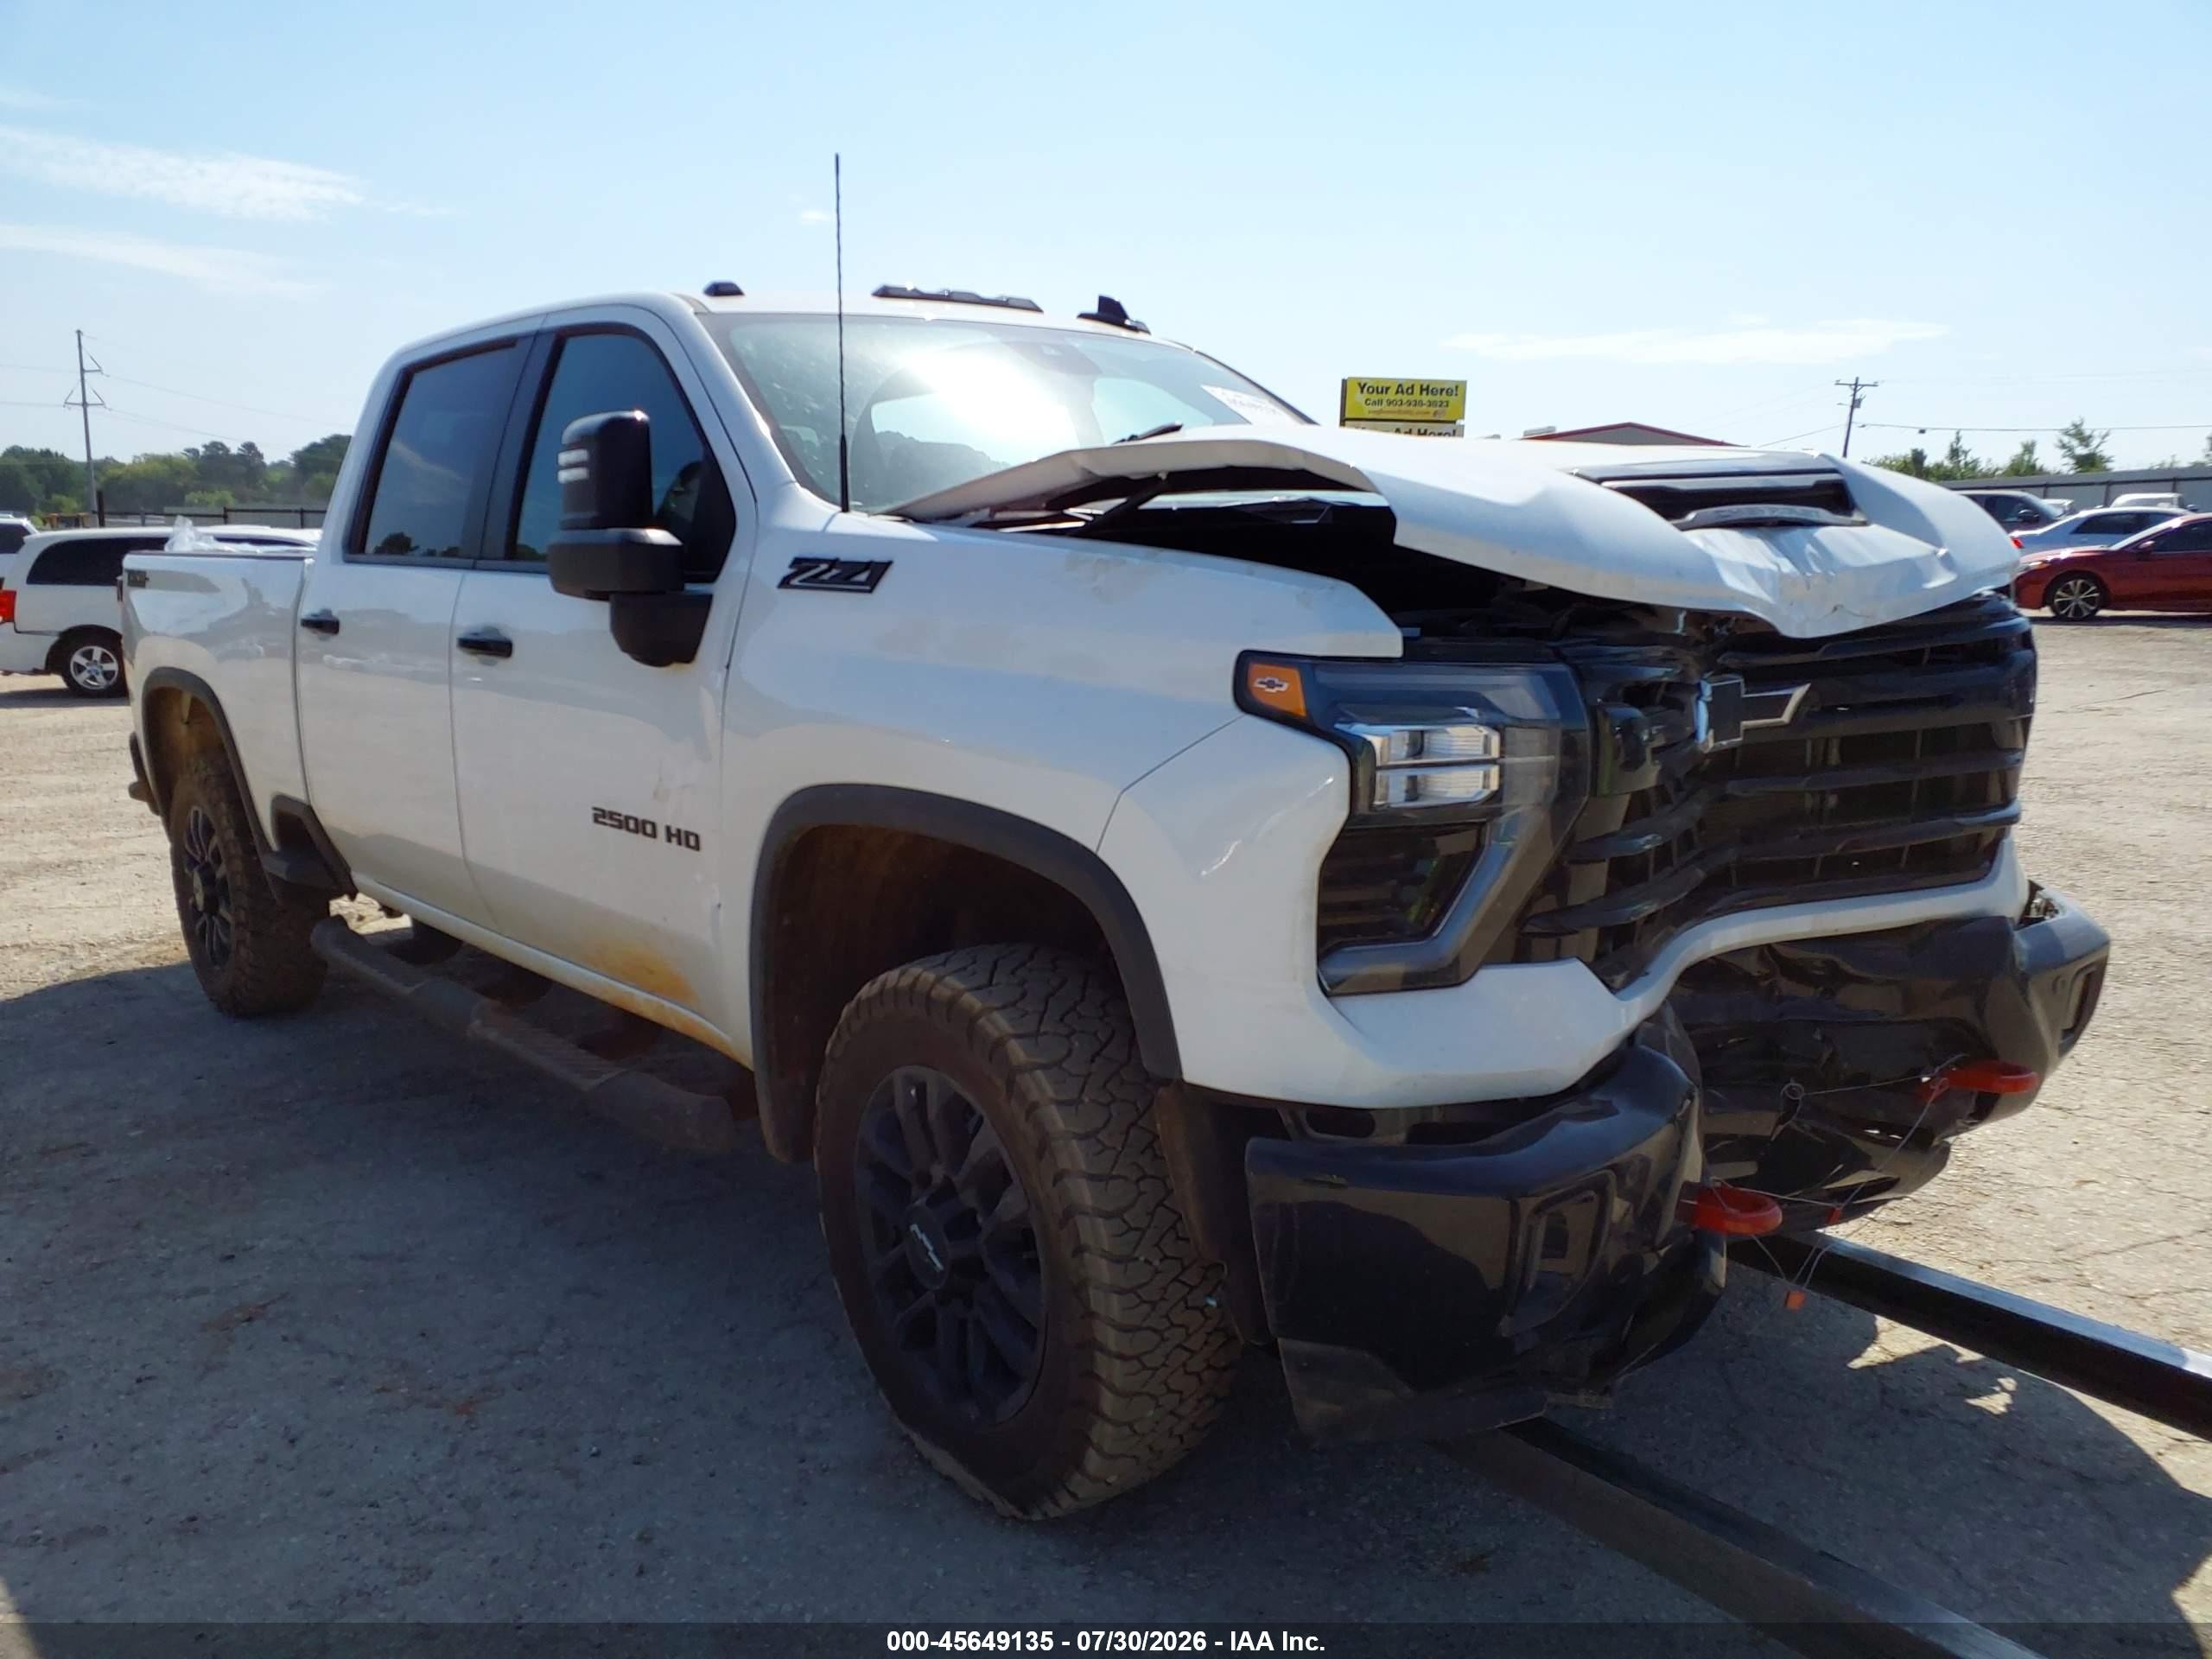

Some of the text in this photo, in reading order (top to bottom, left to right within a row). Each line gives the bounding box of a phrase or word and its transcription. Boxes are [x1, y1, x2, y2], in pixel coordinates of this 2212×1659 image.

[1357, 383, 1459, 397] Your Ad Here!
[1364, 397, 1382, 406] Call
[592, 806, 700, 851] 2500 HD
